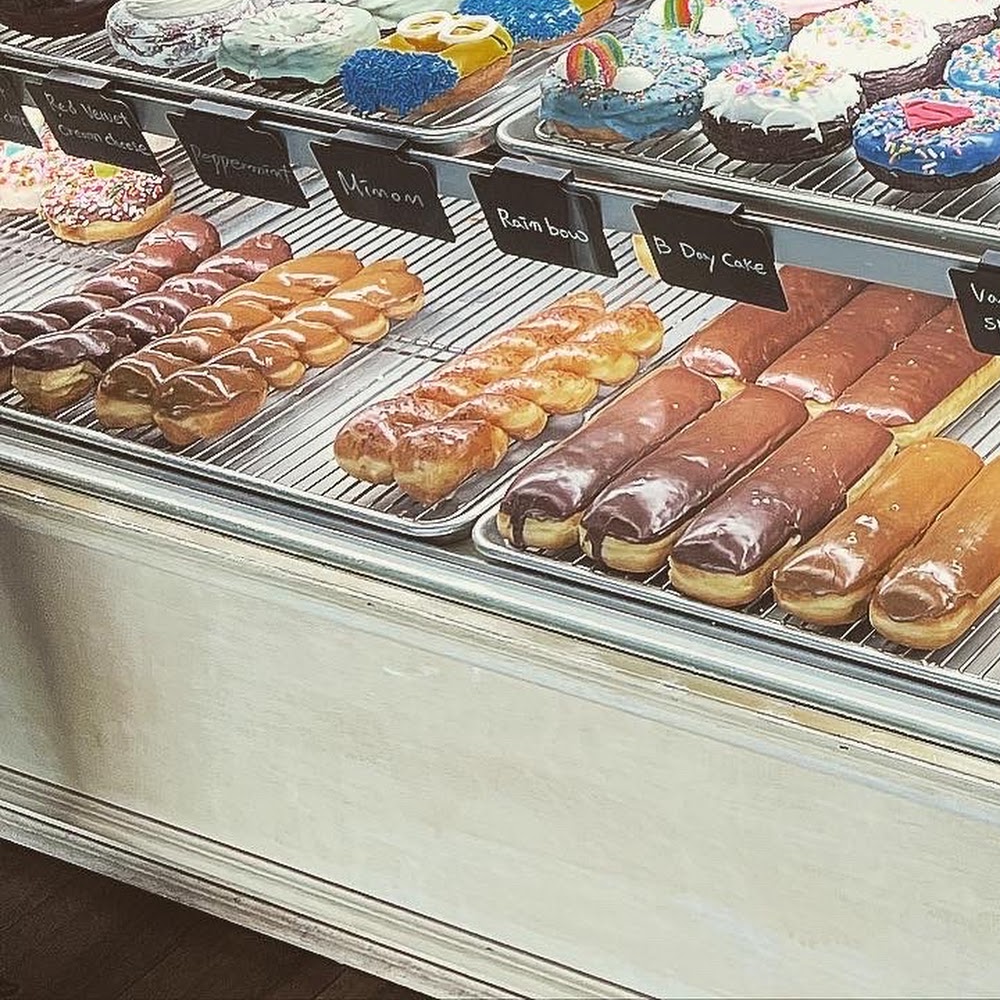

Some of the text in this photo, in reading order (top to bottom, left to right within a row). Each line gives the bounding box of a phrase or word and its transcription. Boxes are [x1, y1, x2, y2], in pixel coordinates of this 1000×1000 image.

[44, 91, 77, 115] Red
[190, 143, 291, 184] Peppermint
[497, 207, 590, 243] Rainbow
[653, 235, 768, 277] B Day Cake
